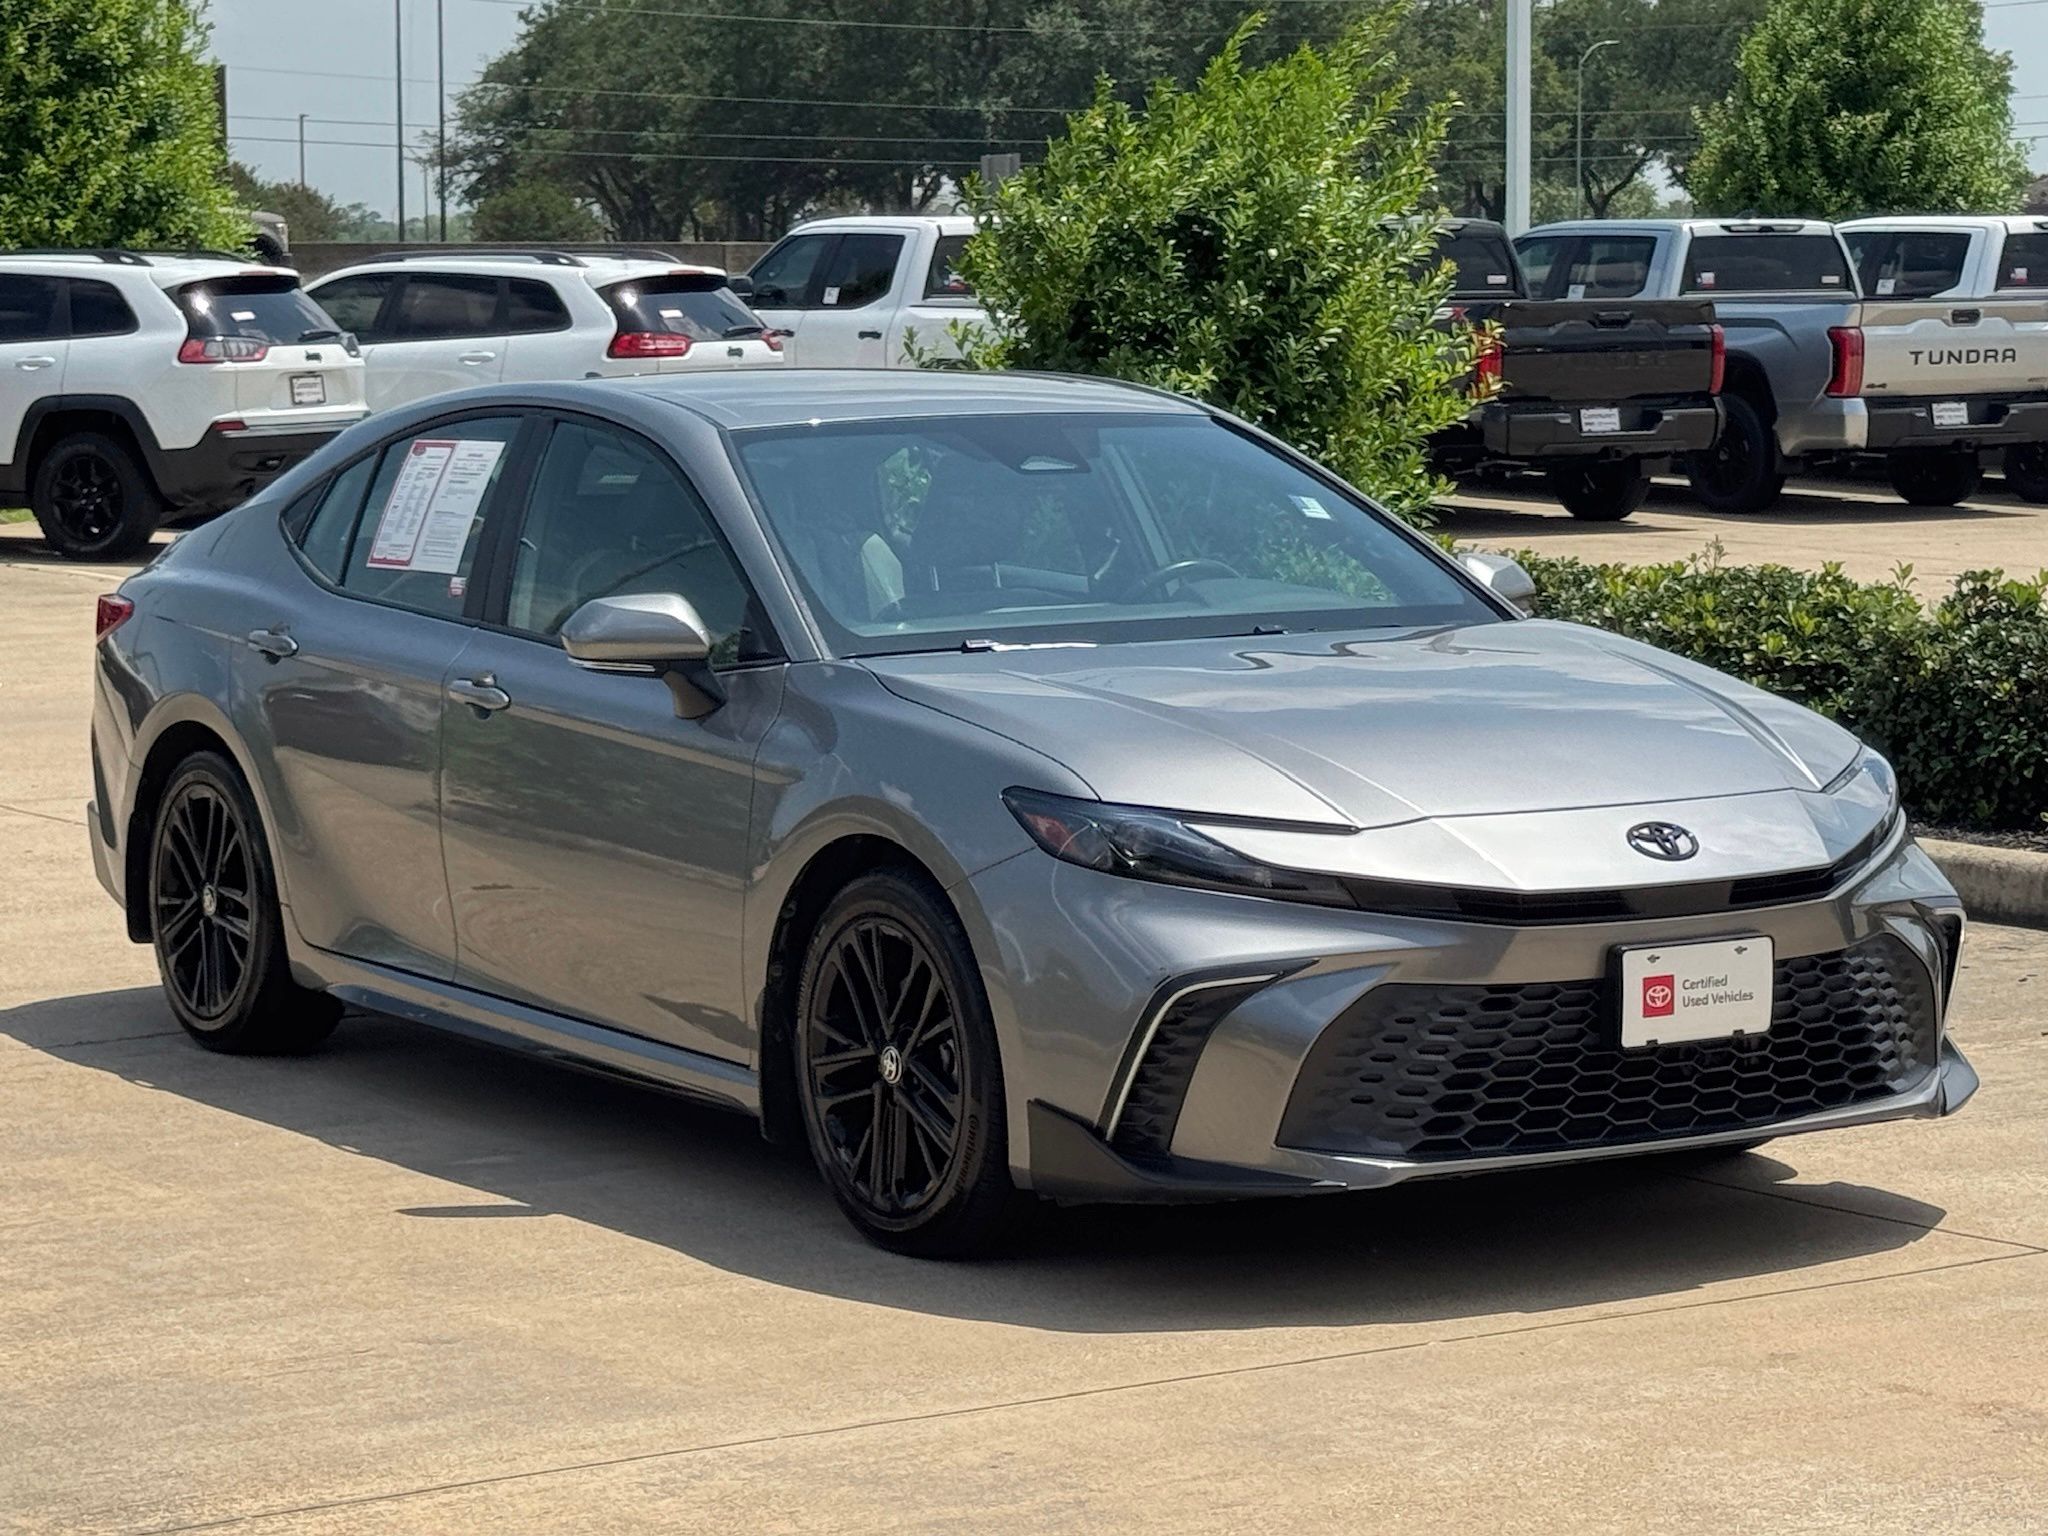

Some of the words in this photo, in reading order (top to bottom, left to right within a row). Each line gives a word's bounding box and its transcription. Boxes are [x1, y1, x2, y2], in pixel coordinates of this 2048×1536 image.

[1909, 348, 2017, 366] TUNDRA
[1682, 974, 1728, 990] Certified
[1682, 994, 1709, 1008] Used
[1711, 989, 1754, 1004] Vehicles
